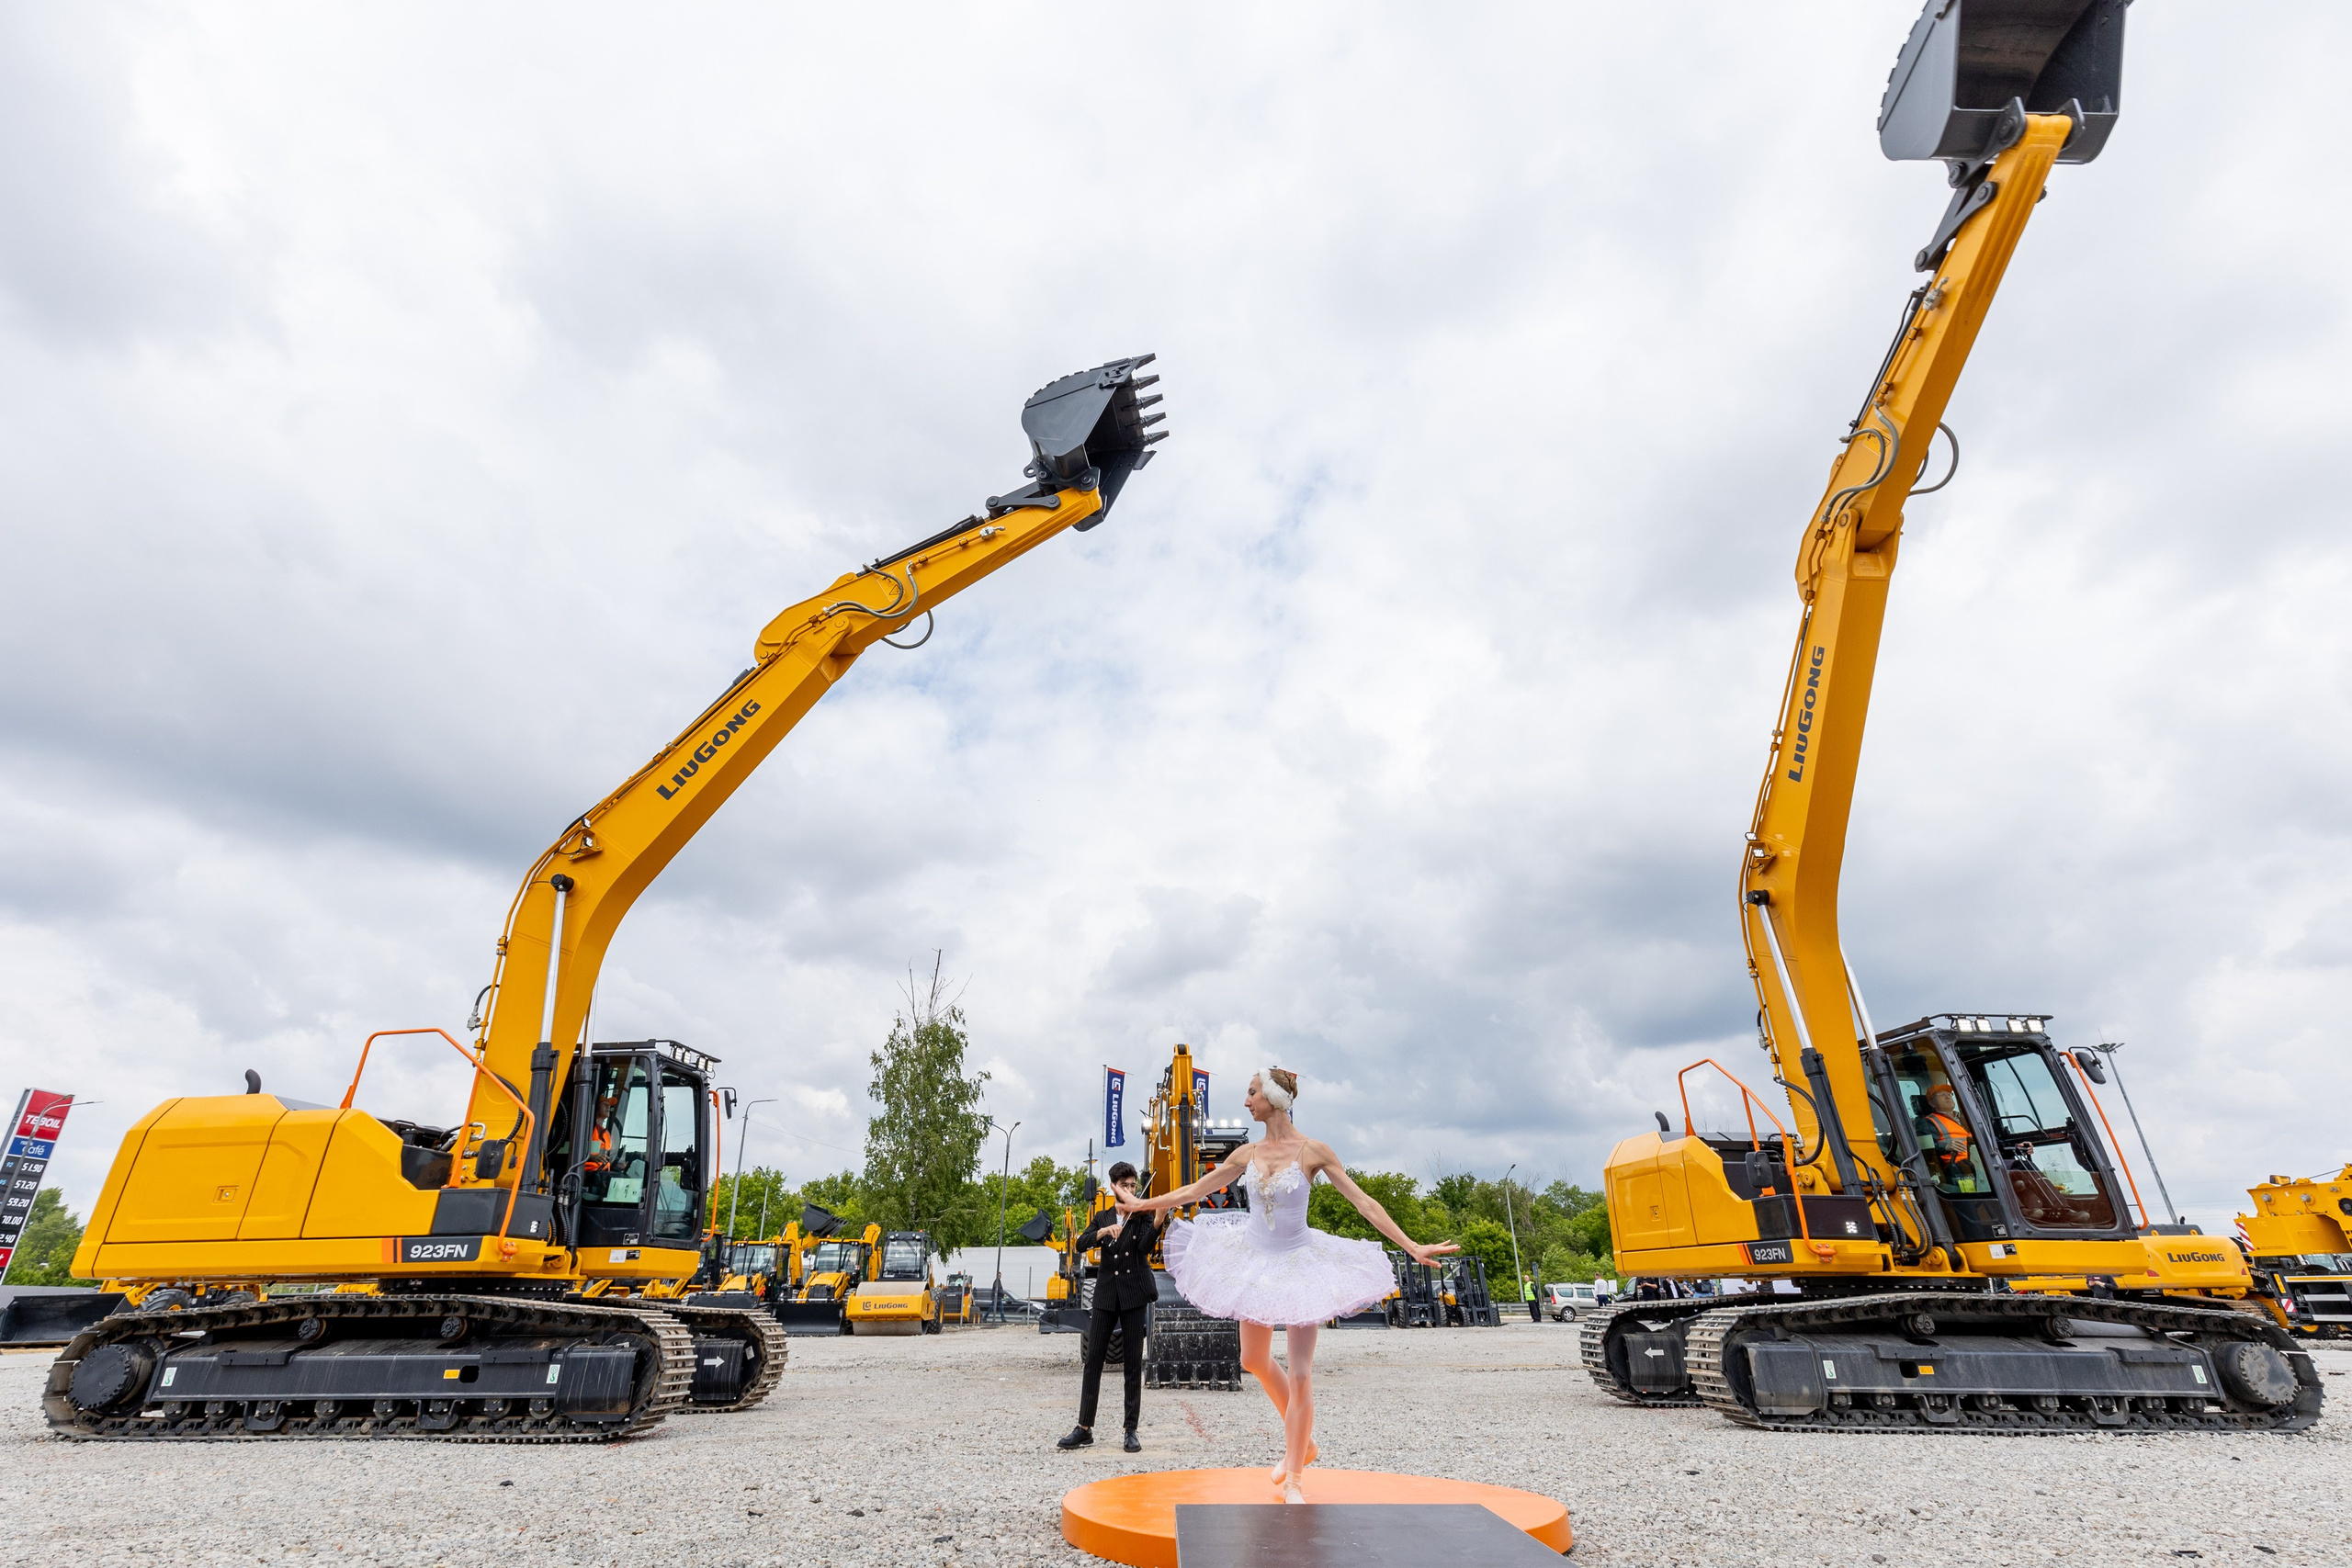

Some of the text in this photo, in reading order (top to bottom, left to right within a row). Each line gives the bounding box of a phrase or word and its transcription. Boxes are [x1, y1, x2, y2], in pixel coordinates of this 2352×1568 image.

[1788, 646, 1825, 783] LIUGONG
[656, 699, 762, 801] LIUGONG
[25, 1114, 62, 1129] TEBOIL
[1111, 1093, 1120, 1144] LIUGONG
[21, 1162, 44, 1173] 51.90
[14, 1179, 37, 1190] 57.20
[6, 1198, 30, 1208] 59.20
[1, 1215, 23, 1225] 70.00
[410, 1244, 469, 1258] 923FN
[1754, 1247, 1786, 1260] 923FN
[2167, 1252, 2225, 1263] LIUGONG
